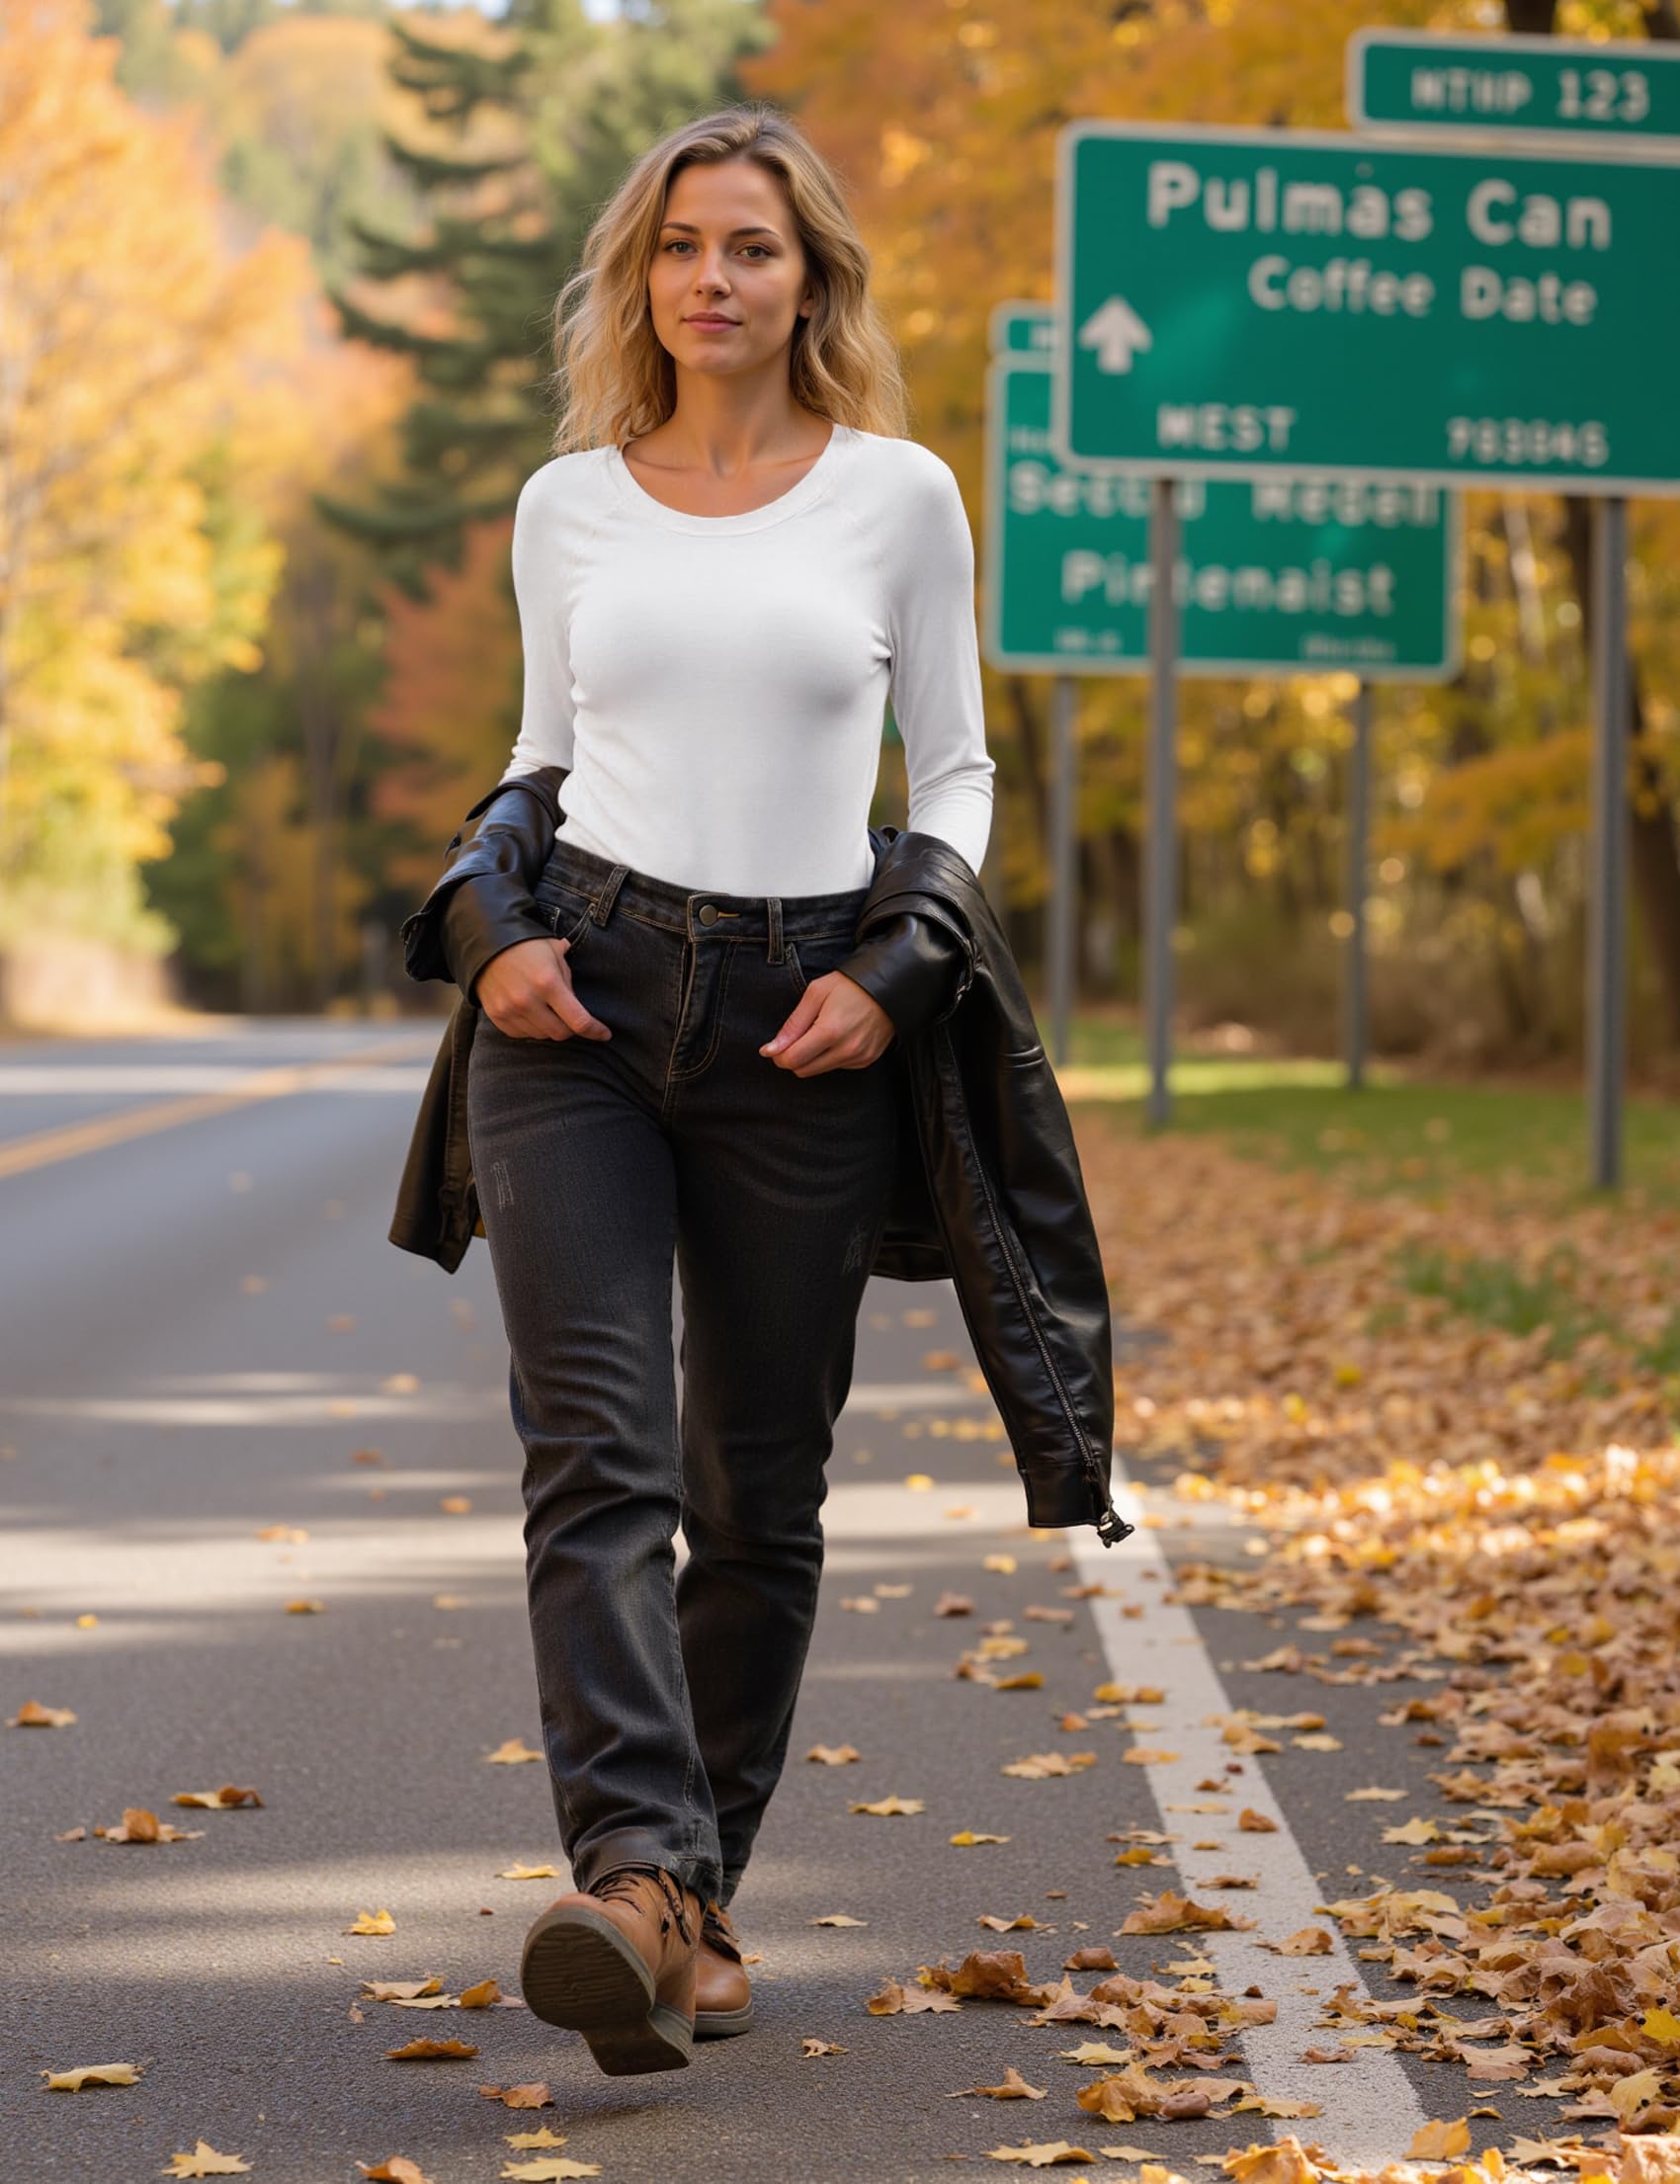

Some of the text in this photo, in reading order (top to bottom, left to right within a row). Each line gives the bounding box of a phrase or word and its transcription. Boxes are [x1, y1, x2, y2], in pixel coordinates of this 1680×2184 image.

[1557, 69, 1649, 122] 123
[1467, 178, 1612, 250] Can
[1248, 255, 1598, 324] Coffee Date
